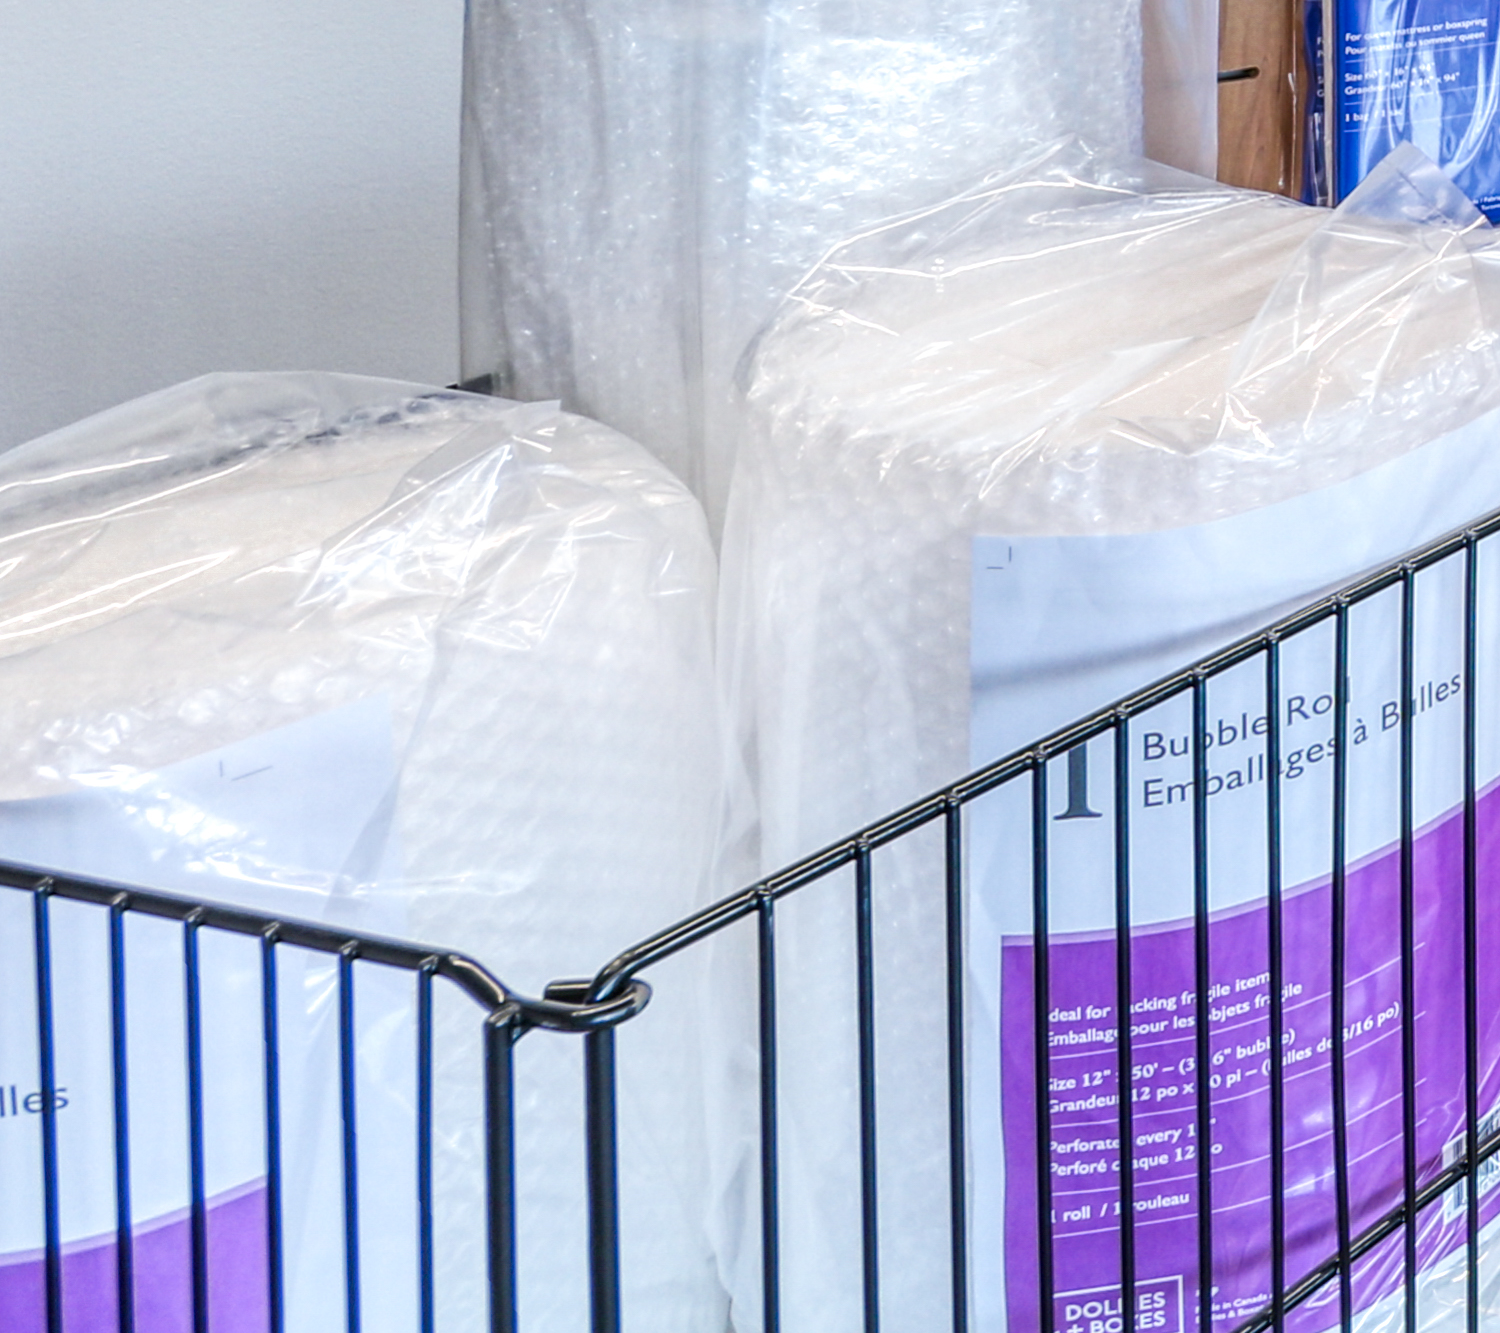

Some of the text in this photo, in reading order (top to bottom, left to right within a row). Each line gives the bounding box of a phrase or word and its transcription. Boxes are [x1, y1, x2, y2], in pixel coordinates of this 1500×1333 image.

[1353, 718, 1368, 745] à
[1049, 984, 1231, 1023] deal for frile
[1173, 1015, 1195, 1029] les
[1208, 1001, 1250, 1022] bjets
[1131, 1083, 1195, 1102] 12 po x
[1136, 1128, 1182, 1147] every
[1063, 1205, 1091, 1222] roll
